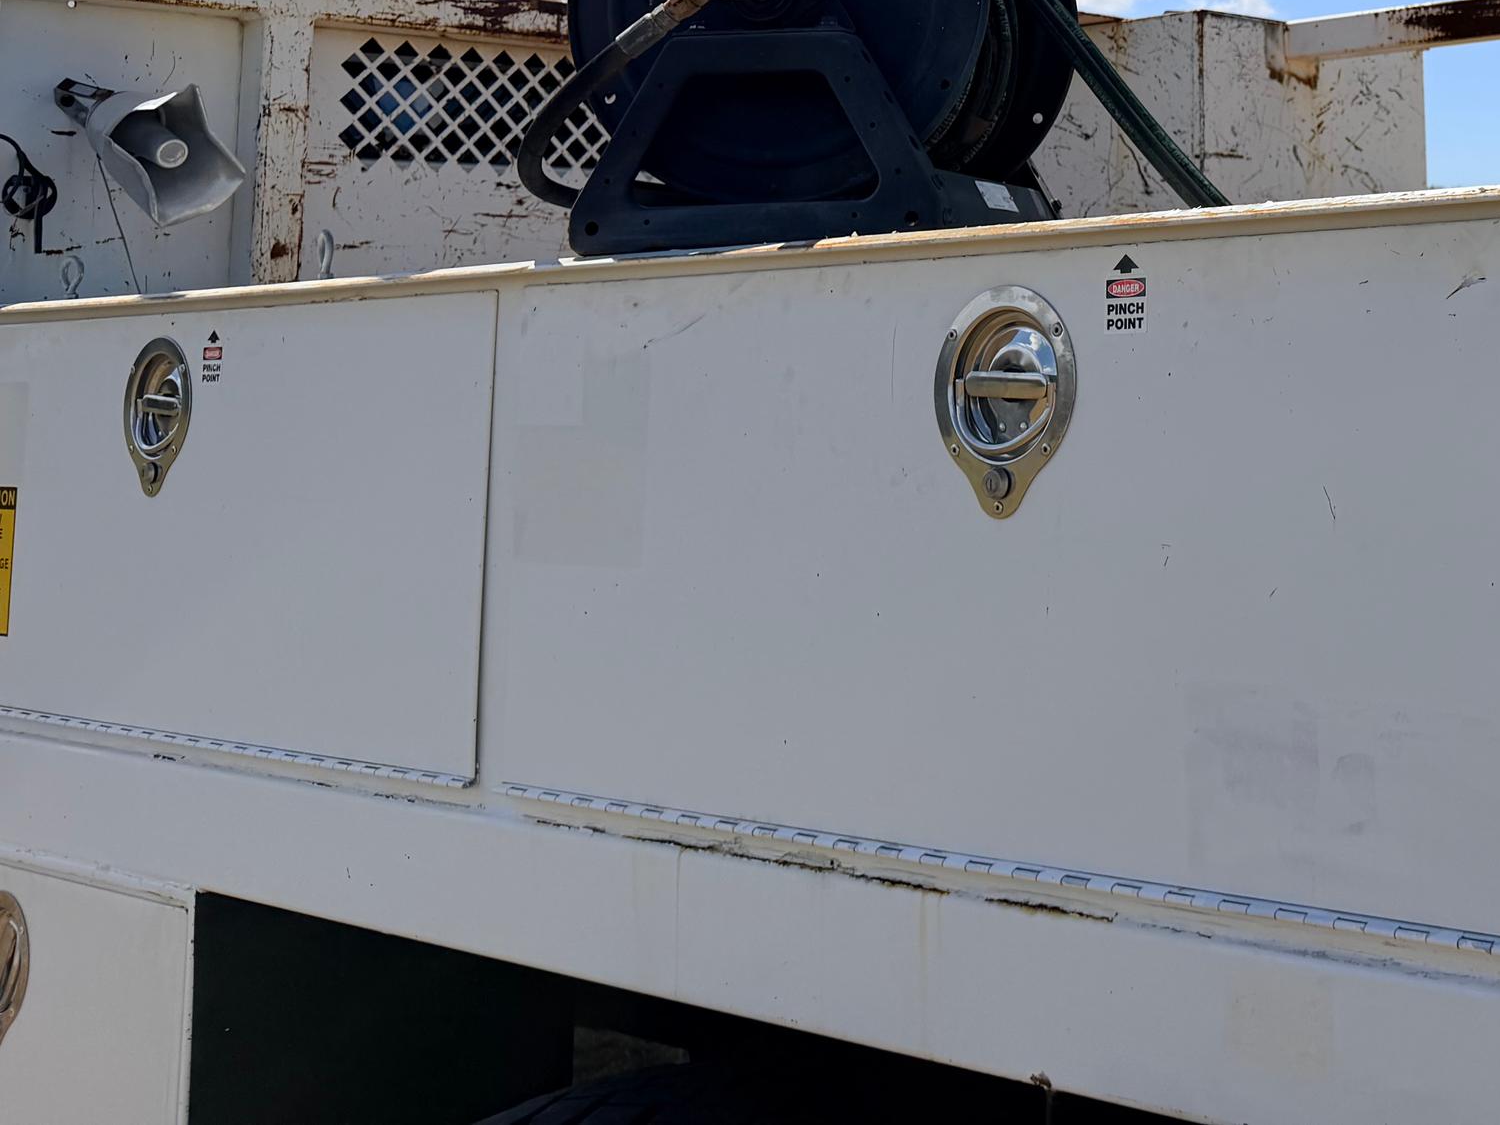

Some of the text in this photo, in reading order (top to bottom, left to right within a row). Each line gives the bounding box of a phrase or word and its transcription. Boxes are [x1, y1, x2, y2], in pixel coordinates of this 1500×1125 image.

[1113, 284, 1139, 293] DANGER
[1107, 302, 1144, 315] PINCH
[1107, 318, 1143, 330] POINT
[203, 364, 221, 372] PINCH
[202, 374, 220, 382] POINT
